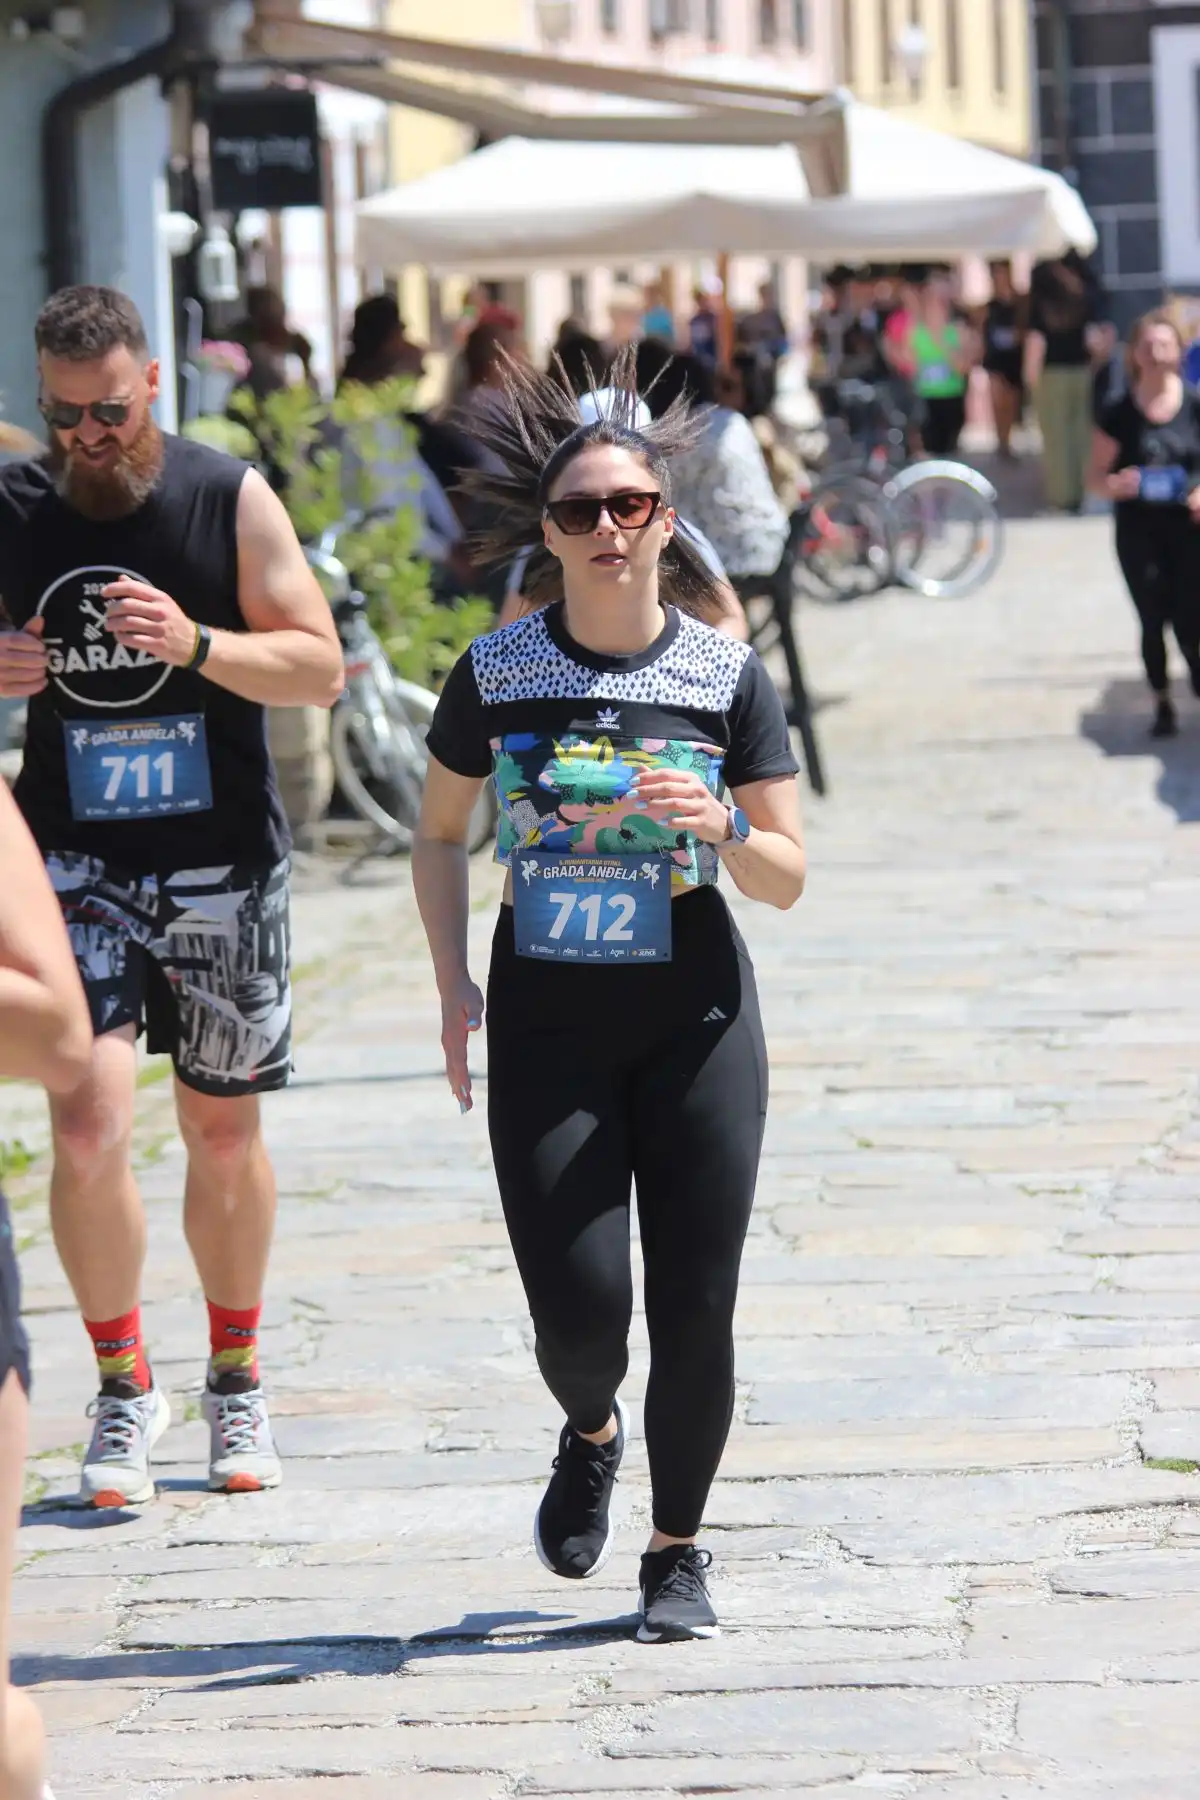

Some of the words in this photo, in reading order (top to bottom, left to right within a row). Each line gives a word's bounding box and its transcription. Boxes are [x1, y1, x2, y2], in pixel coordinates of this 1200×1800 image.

[91, 731, 128, 746] GRADA
[102, 751, 174, 801] 711
[543, 865, 584, 879] GRADA
[588, 866, 638, 881] ANĐELA
[548, 893, 637, 940] 712
